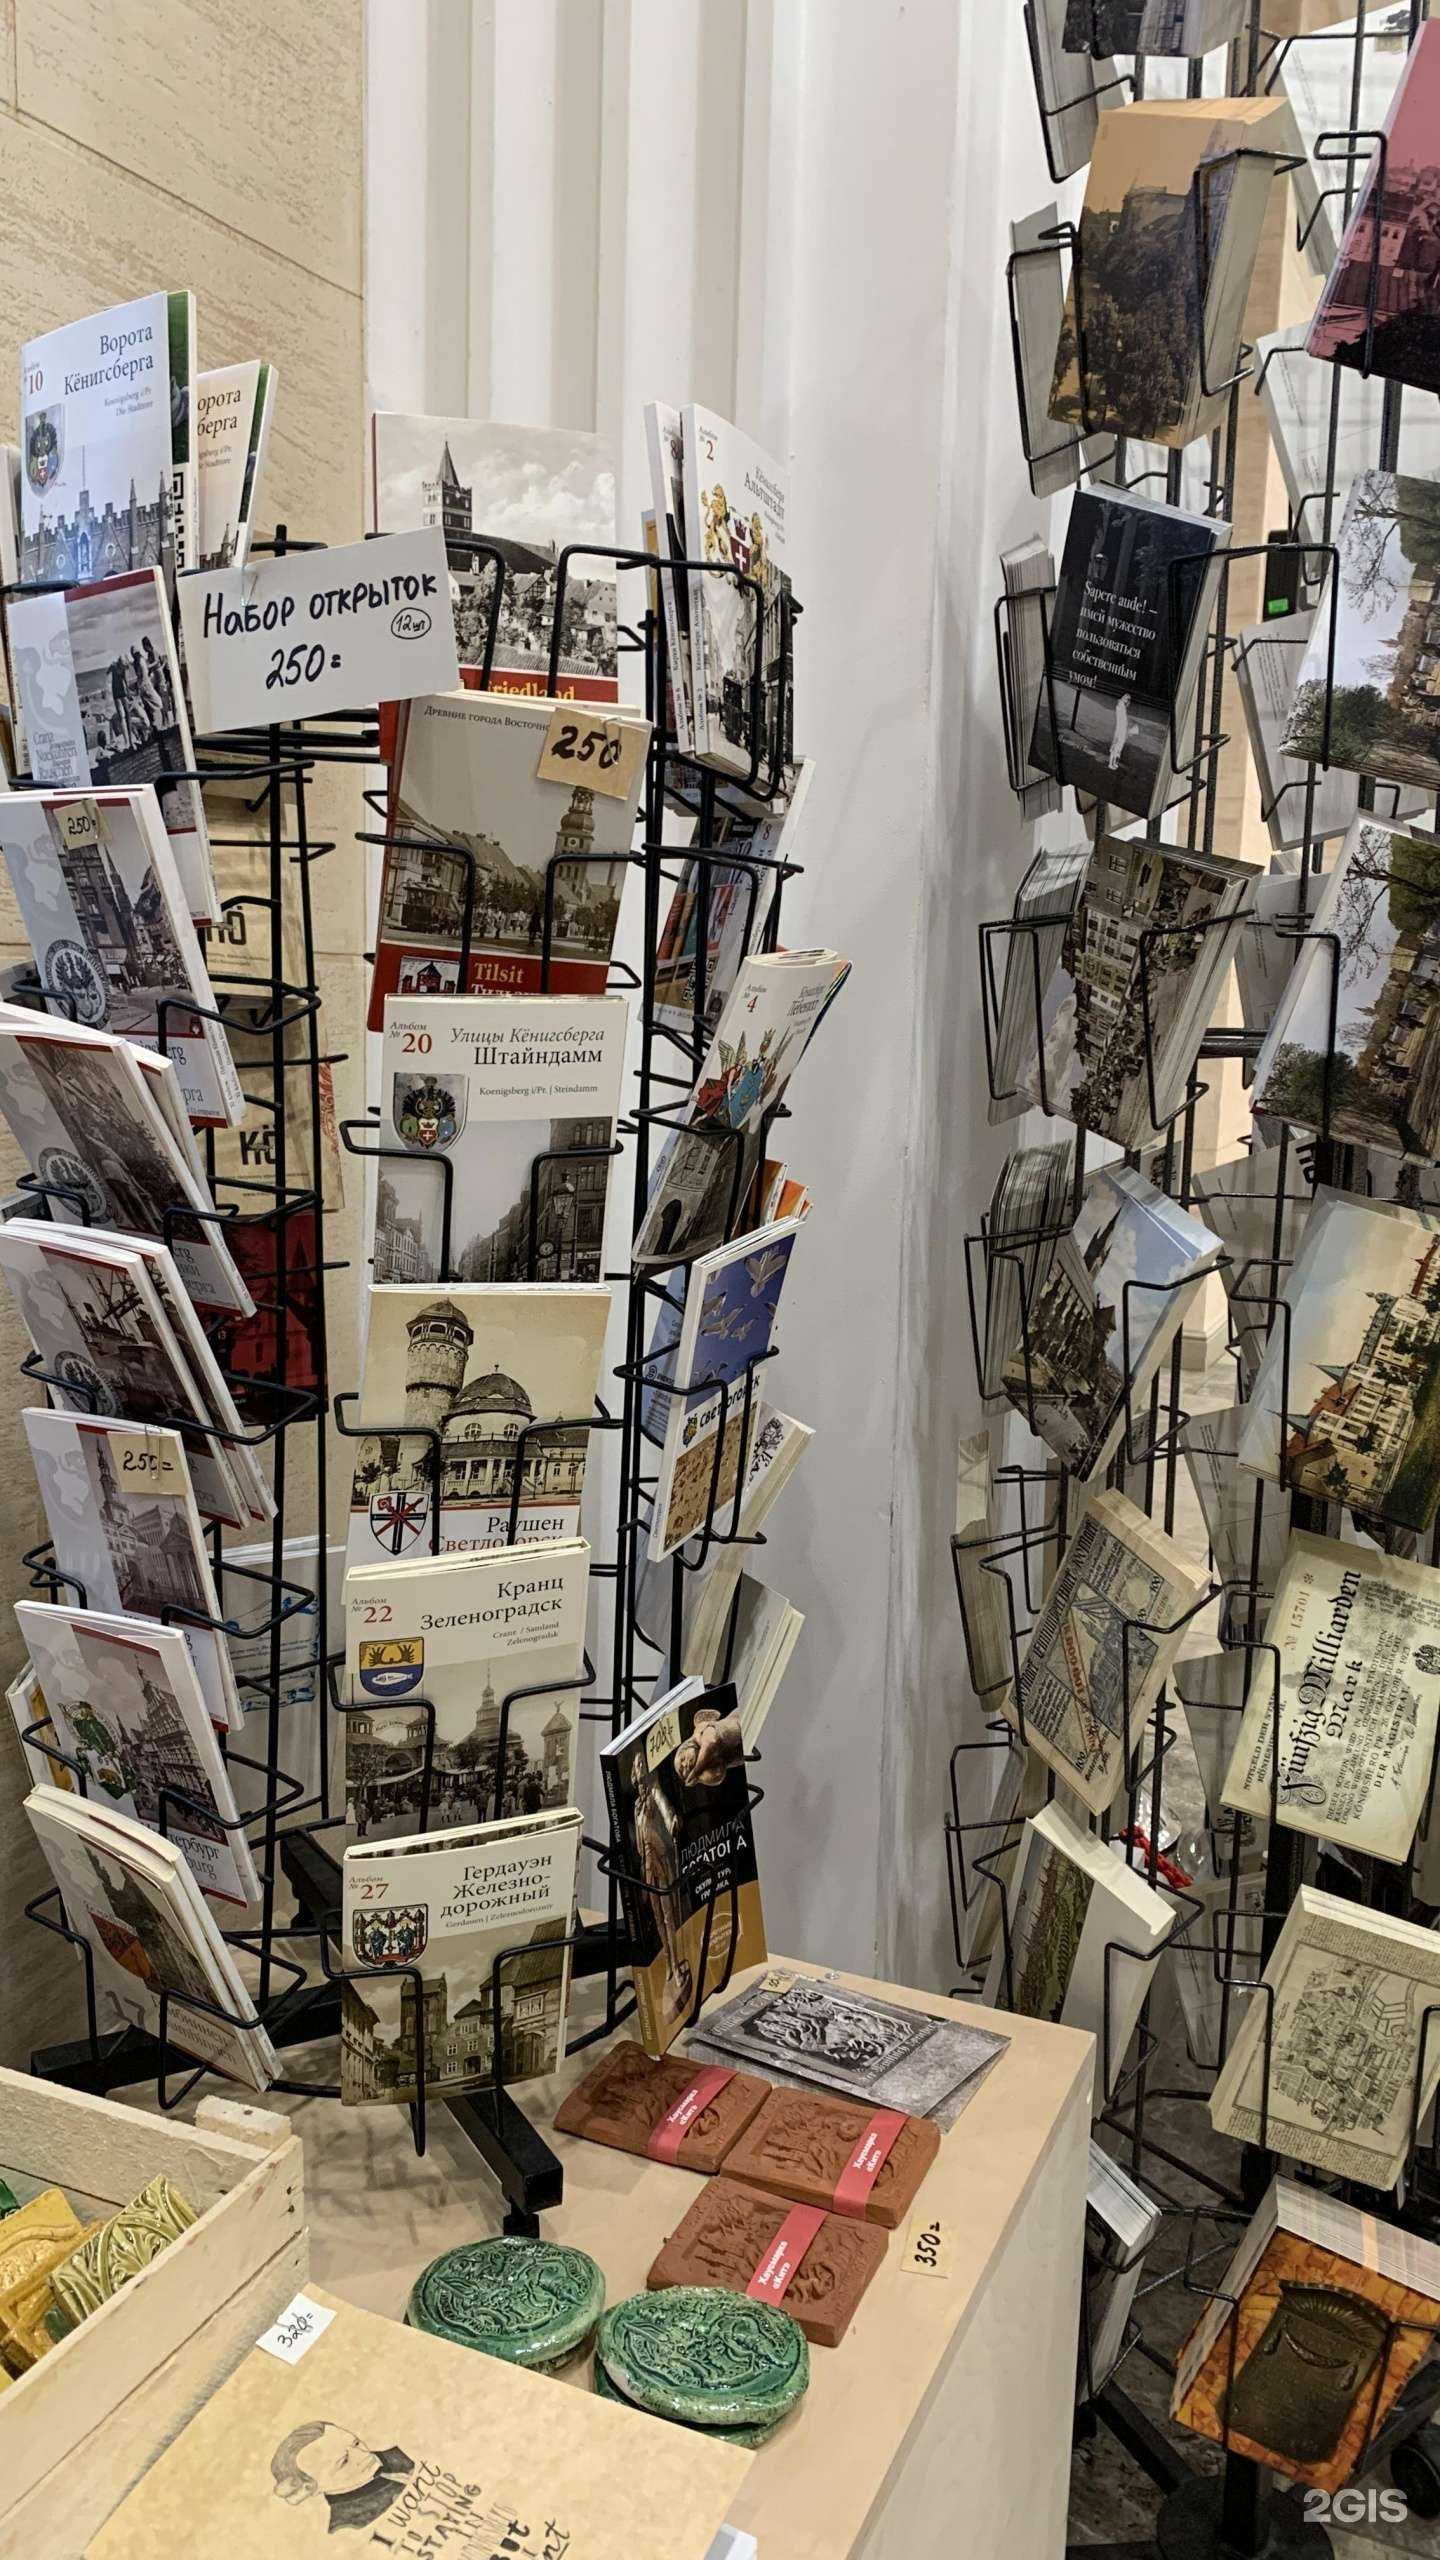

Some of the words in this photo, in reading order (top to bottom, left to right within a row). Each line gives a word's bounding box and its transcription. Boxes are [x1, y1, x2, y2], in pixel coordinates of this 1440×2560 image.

[100, 326, 153, 355] Ворота
[29, 370, 43, 394] 10
[64, 355, 154, 395] Кёнигсберга
[197, 390, 241, 415] орота
[707, 440, 714, 461] 2
[1084, 580, 1117, 604] Sapere
[1118, 596, 1147, 614] aude!
[1080, 606, 1106, 624] имей
[1107, 615, 1156, 640] мужество
[1076, 628, 1141, 659] пользоваться
[1072, 649, 1137, 681] собственным
[1068, 670, 1098, 688] умом!
[474, 963, 525, 984] Tilsit
[747, 995, 758, 1013] 4
[390, 1021, 428, 1031] Альбом
[450, 1027, 504, 1044] Улицы
[509, 1026, 605, 1044] Кёнигсберга
[402, 1033, 433, 1054] 20
[474, 1047, 603, 1067] Штайндамм
[554, 1085, 598, 1094] Steindamm
[487, 1516, 565, 1533] Раушен
[497, 1577, 564, 1600] Кранц
[363, 1605, 393, 1624] 22
[420, 1597, 562, 1631] Зеленоградск
[463, 1855, 553, 1882] Гердауэн
[361, 1883, 390, 1900] 27
[452, 1874, 552, 1901] Железно-
[440, 1886, 551, 1919] дорожный
[388, 2460, 441, 2529] want
[416, 2483, 482, 2560] STAYING
